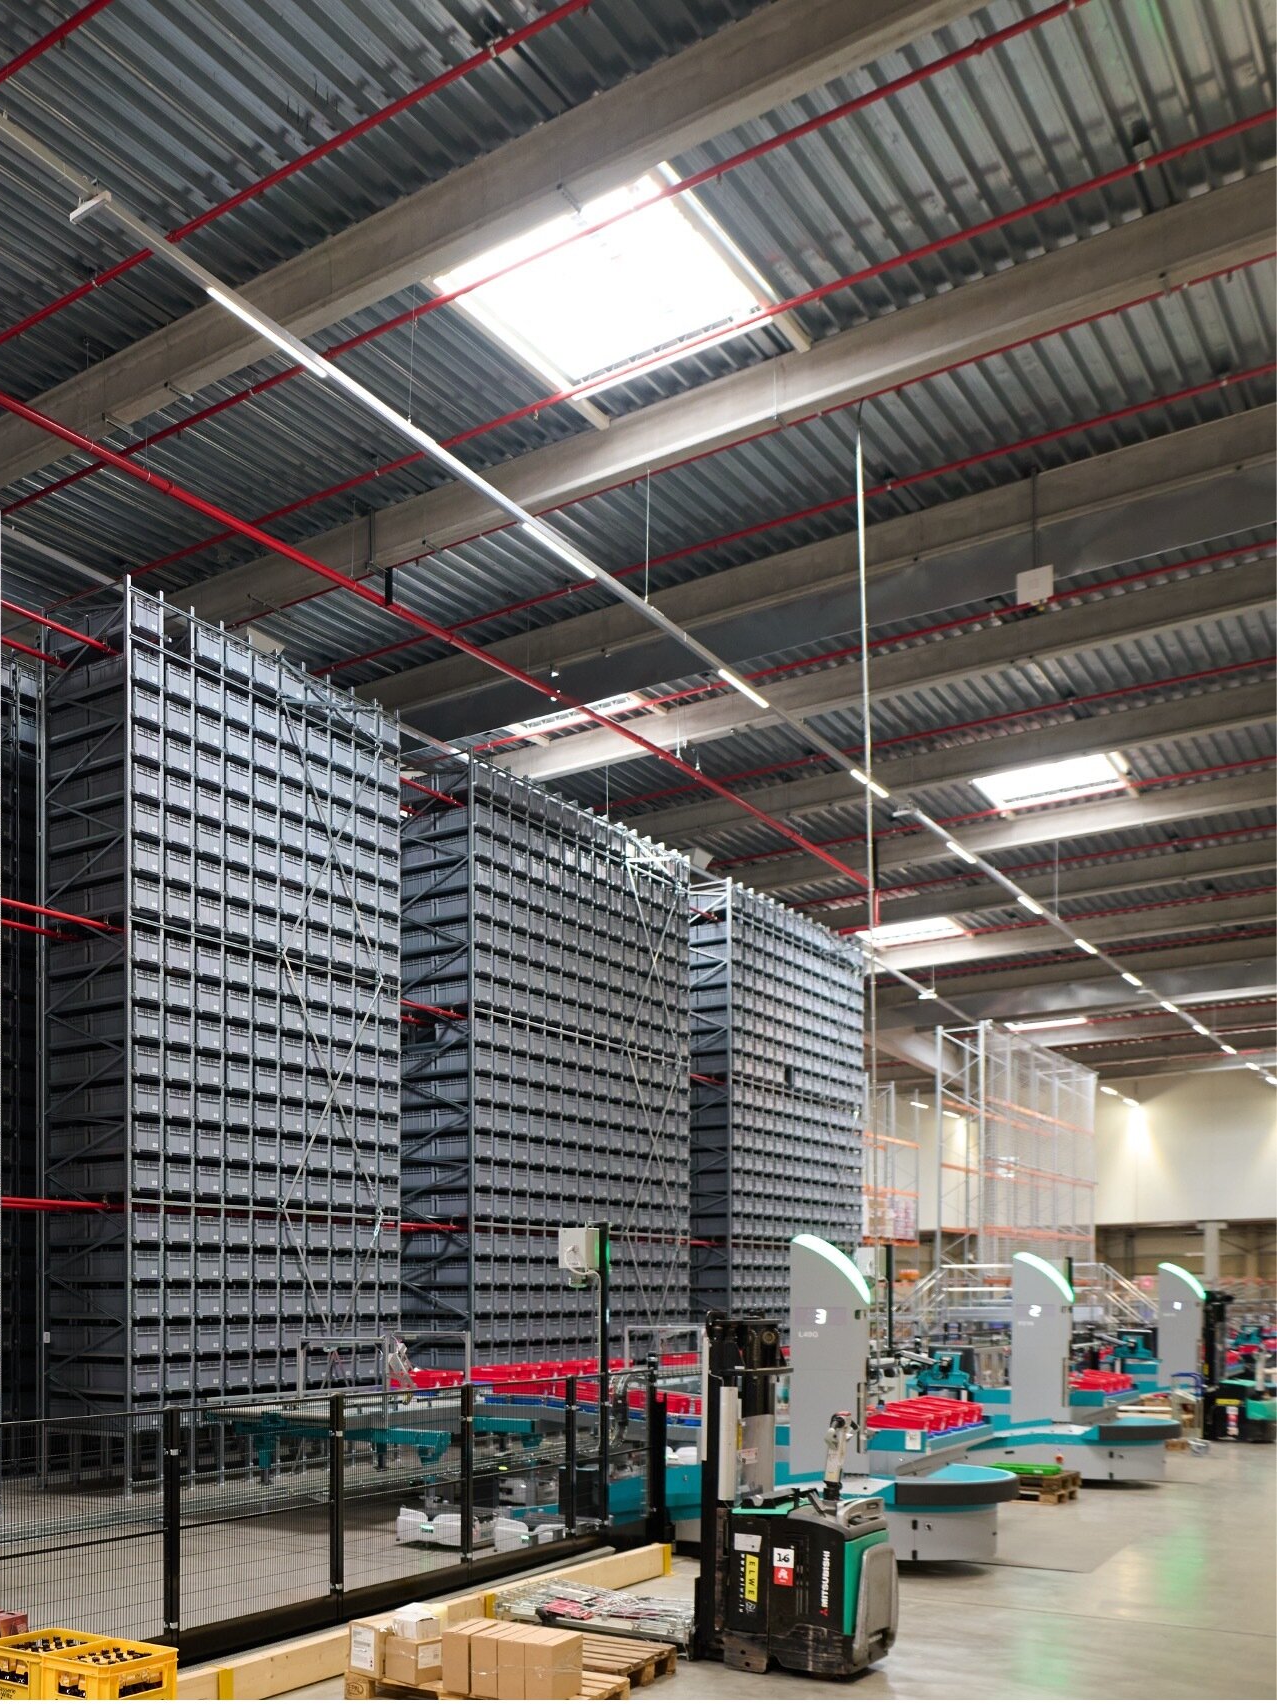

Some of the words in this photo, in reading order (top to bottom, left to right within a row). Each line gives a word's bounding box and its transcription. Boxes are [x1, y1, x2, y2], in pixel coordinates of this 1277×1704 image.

[815, 1308, 827, 1325] 3
[1028, 1304, 1042, 1317] 2
[776, 1552, 790, 1563] 16
[747, 1560, 756, 1595] ELWE
[821, 1550, 830, 1608] MITSUBISHI
